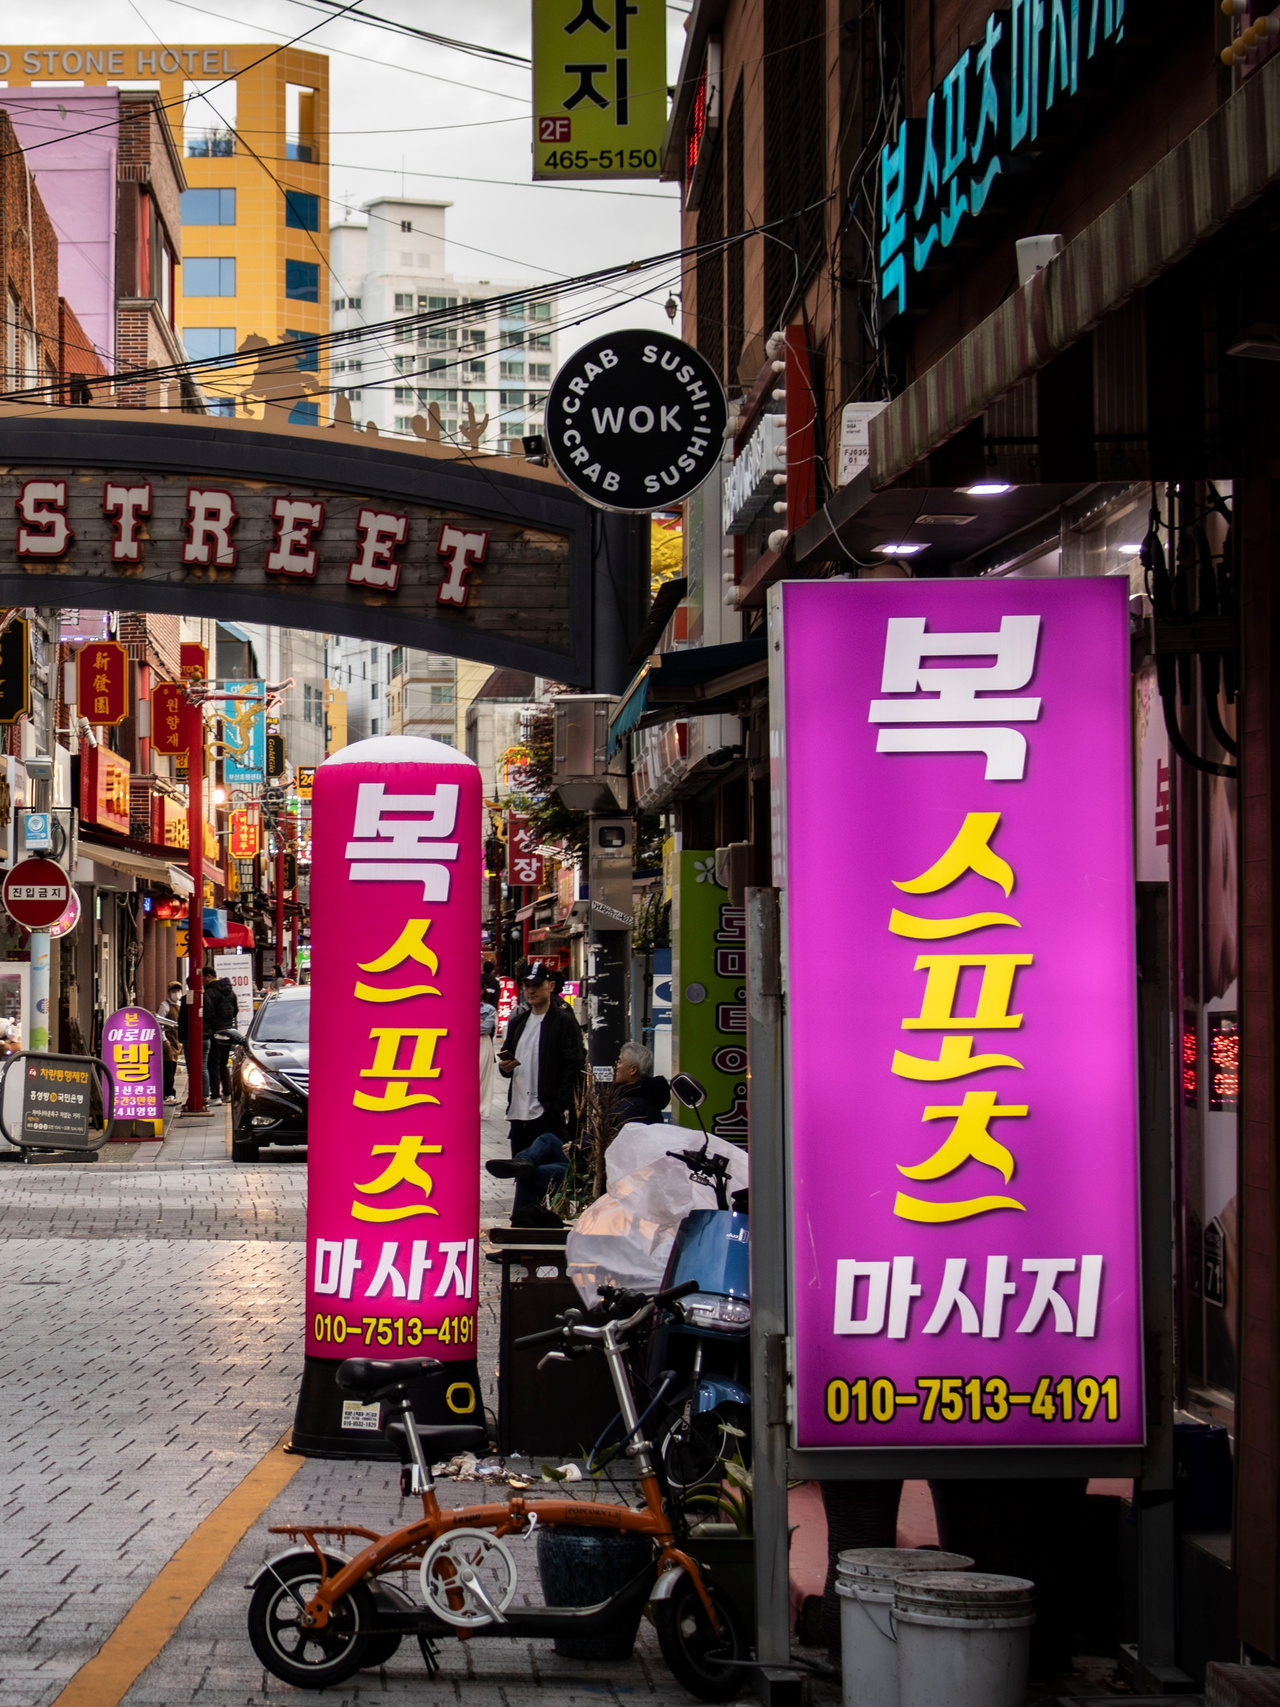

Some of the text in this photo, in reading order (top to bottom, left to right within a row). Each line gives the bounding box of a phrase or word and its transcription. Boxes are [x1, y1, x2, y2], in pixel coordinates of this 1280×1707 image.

[22, 50, 125, 75] STONE
[137, 49, 237, 75] HOTEL
[540, 120, 570, 140] 2F
[544, 149, 658, 170] 465-5150
[562, 344, 712, 413] CRAB SUSHI
[591, 404, 683, 435] WOK
[562, 429, 622, 492] CRAB
[643, 424, 712, 493] SUSHI
[16, 480, 490, 608] STREET
[300, 774, 314, 786] 24
[12, 887, 61, 899] 진입금지
[867, 614, 1042, 1223] 복 스포츠
[123, 1012, 139, 1027] 본
[344, 782, 459, 1223] 복 스포츠
[108, 1028, 156, 1042] 아로마
[113, 1043, 154, 1082] 발
[113, 1106, 157, 1117] 4시영업
[313, 1237, 475, 1301] 마사지
[833, 1254, 1104, 1339] 마사지
[314, 1313, 475, 1347] 010-7513-4191
[825, 1375, 1121, 1425] 010-7513-4191
